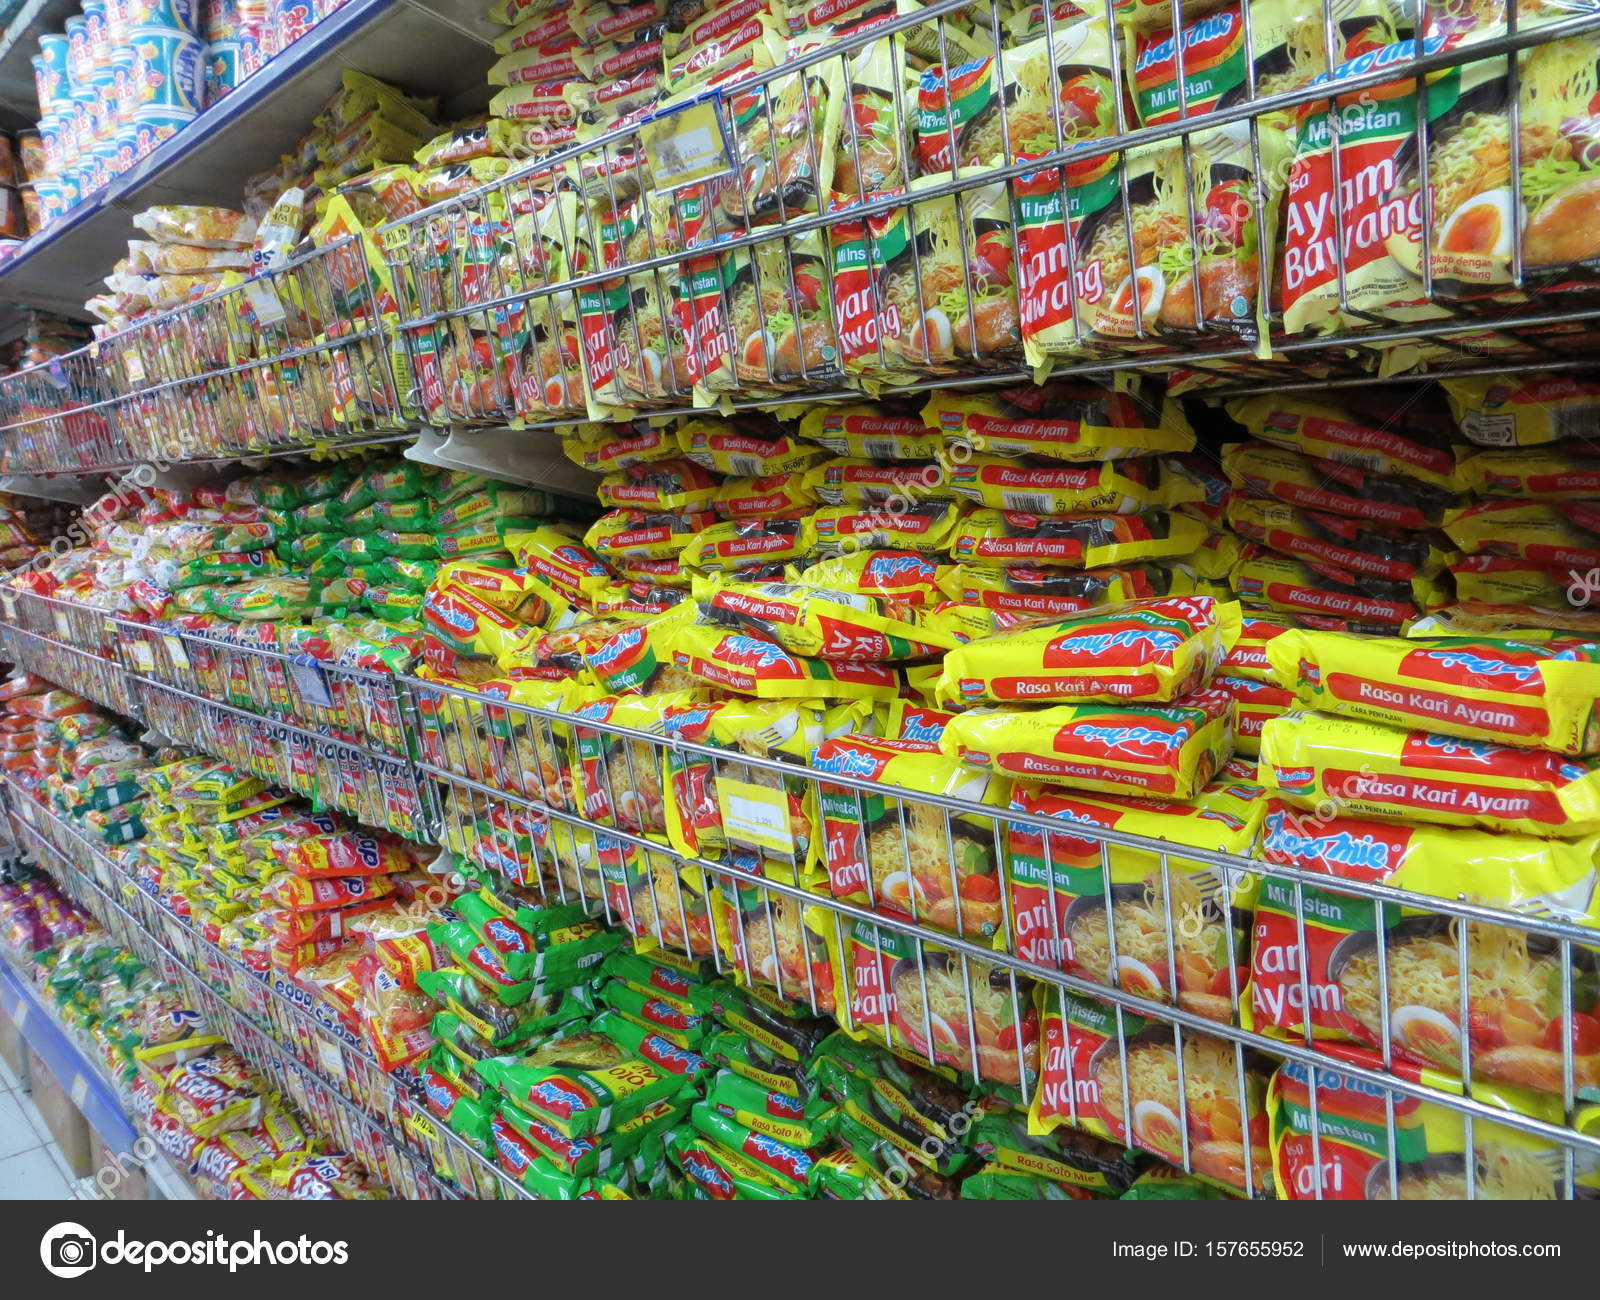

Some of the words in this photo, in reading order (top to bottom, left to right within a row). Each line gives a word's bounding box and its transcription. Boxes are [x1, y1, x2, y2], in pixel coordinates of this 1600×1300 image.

[984, 421, 1008, 433] Rasa
[1011, 423, 1035, 436] Kari
[1036, 424, 1069, 439] Ayam
[1325, 424, 1359, 441] Rasa
[1363, 429, 1392, 447] Kari
[1395, 440, 1434, 464] Ayam
[1029, 472, 1054, 484] Kari
[1295, 488, 1327, 505] Rasa
[1329, 495, 1357, 511] Kari
[1359, 503, 1402, 522] Ayam
[1015, 541, 1035, 553] Kari
[1037, 542, 1065, 556] Ayam
[1290, 537, 1321, 554] Rasa
[1323, 545, 1348, 562] Kari
[1350, 554, 1391, 574] Ayam
[999, 596, 1021, 608] Rasa
[1023, 598, 1046, 610] Kari
[1047, 600, 1079, 614] Ayam
[1289, 588, 1321, 605] Rasa
[1324, 594, 1351, 610] Kari
[1353, 601, 1396, 619] Ayam
[1016, 681, 1052, 695] Rasa
[1055, 680, 1086, 693] Kari
[1090, 682, 1133, 698] Ayam
[1359, 682, 1404, 705] Rasa
[1409, 694, 1449, 714] Kari
[1454, 702, 1516, 729] Ayam
[1023, 757, 1060, 773] Rasa
[1064, 763, 1098, 776] Kari
[1102, 770, 1148, 788] Ayam
[1355, 778, 1405, 800] Rasa
[1411, 783, 1457, 802] Kari
[1462, 791, 1530, 814] Ayam
[1014, 860, 1029, 876] Mi
[1030, 864, 1070, 886] Insan
[1267, 883, 1285, 900] Mi
[752, 1118, 771, 1132] Rasa
[772, 1123, 792, 1137] Soto
[860, 1115, 880, 1131] Rasa
[1017, 1155, 1045, 1171] Rasa
[1046, 1161, 1072, 1179] Soto
[1074, 1169, 1095, 1183] Mie
